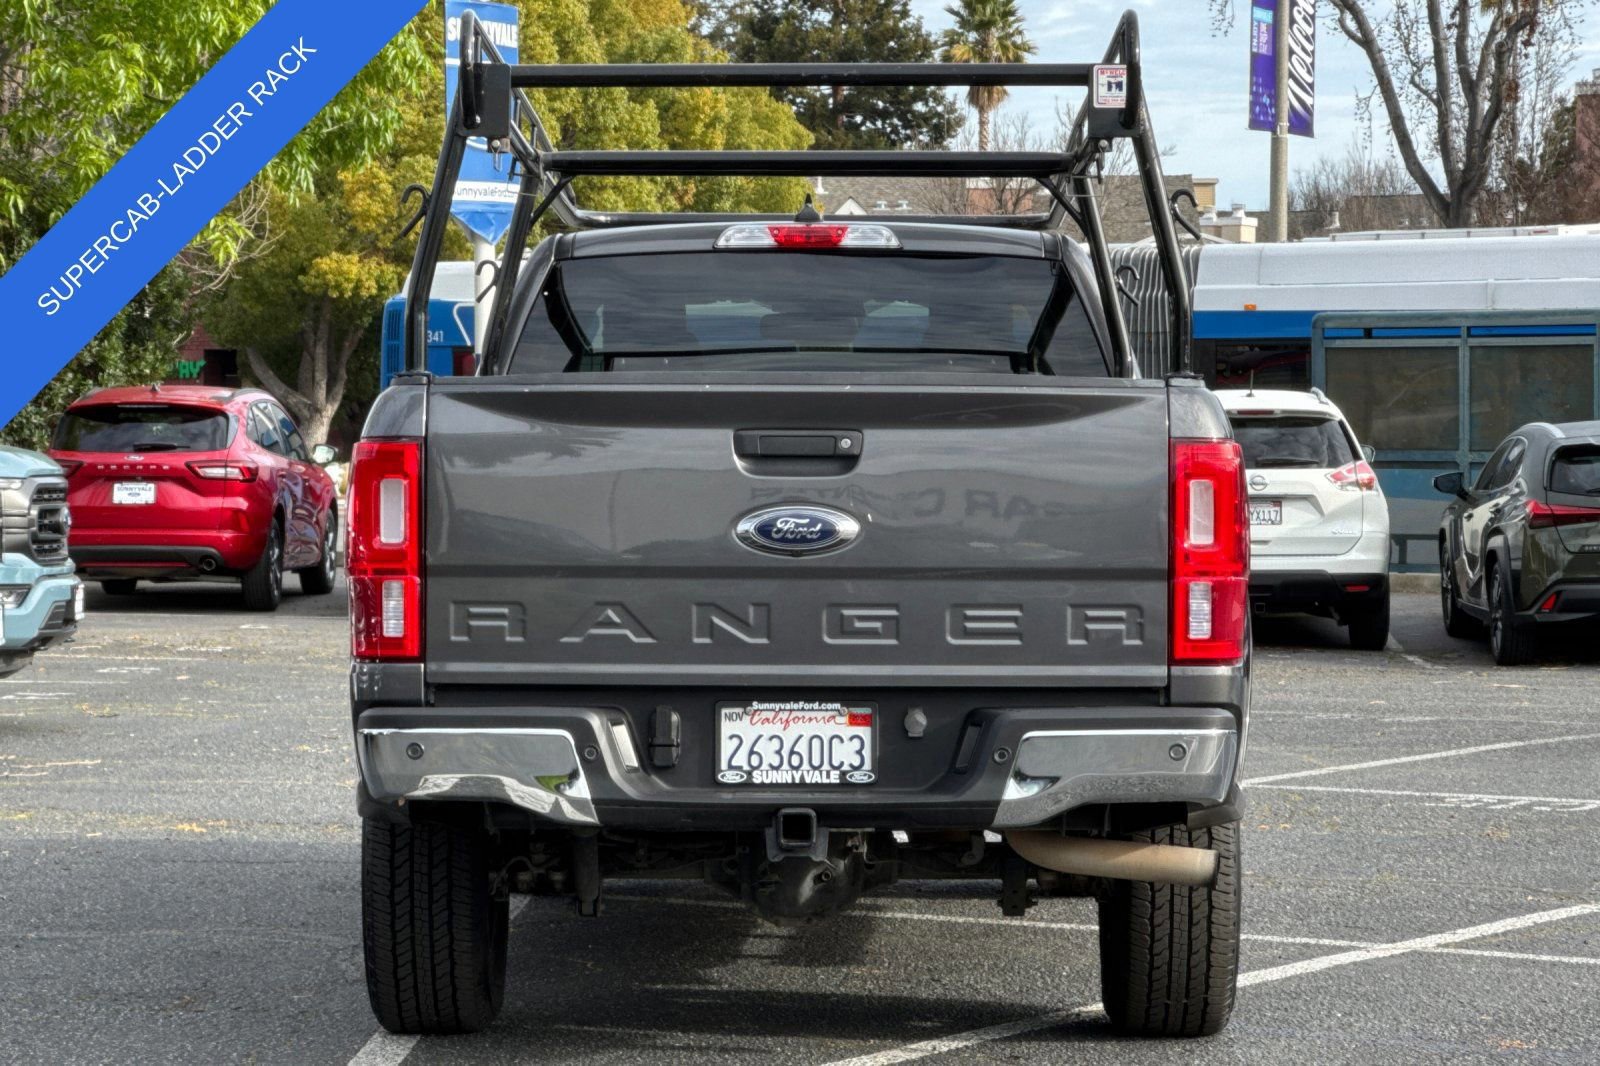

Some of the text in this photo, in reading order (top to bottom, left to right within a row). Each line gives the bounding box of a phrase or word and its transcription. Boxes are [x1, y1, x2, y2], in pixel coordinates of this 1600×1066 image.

[447, 16, 518, 48] SYVALE
[770, 517, 822, 540] Ford
[448, 601, 1145, 646] RANGER
[724, 711, 745, 722] NOV
[751, 701, 841, 712] SunnyvaleFord.com
[750, 711, 839, 731] California
[727, 733, 866, 771] 26360C3
[752, 770, 841, 784] SUNNYVALE
